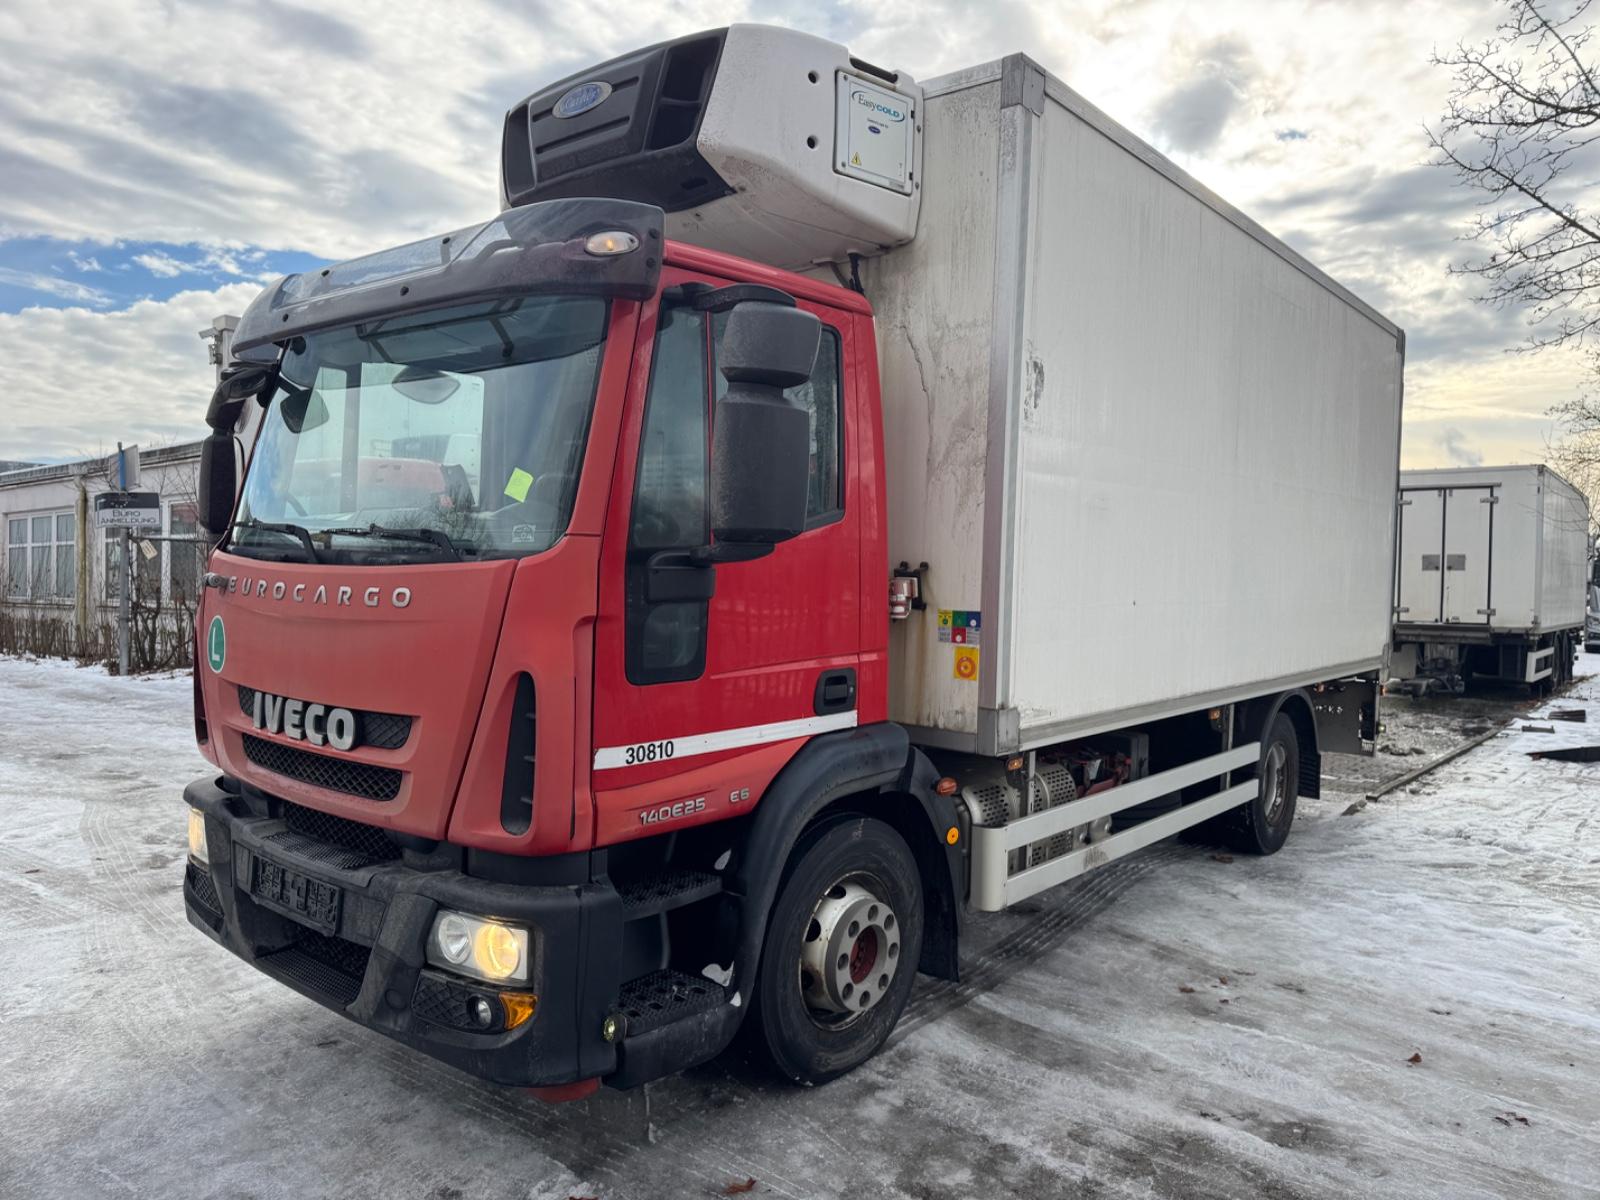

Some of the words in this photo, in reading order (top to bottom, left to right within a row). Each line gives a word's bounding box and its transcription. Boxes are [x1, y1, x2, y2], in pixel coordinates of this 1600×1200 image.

[228, 576, 411, 608] EUROCARGO
[211, 627, 220, 661] L
[253, 691, 355, 751] IVECO
[625, 740, 674, 765] 30810
[730, 788, 750, 803] E6
[640, 797, 706, 825] 140E25
